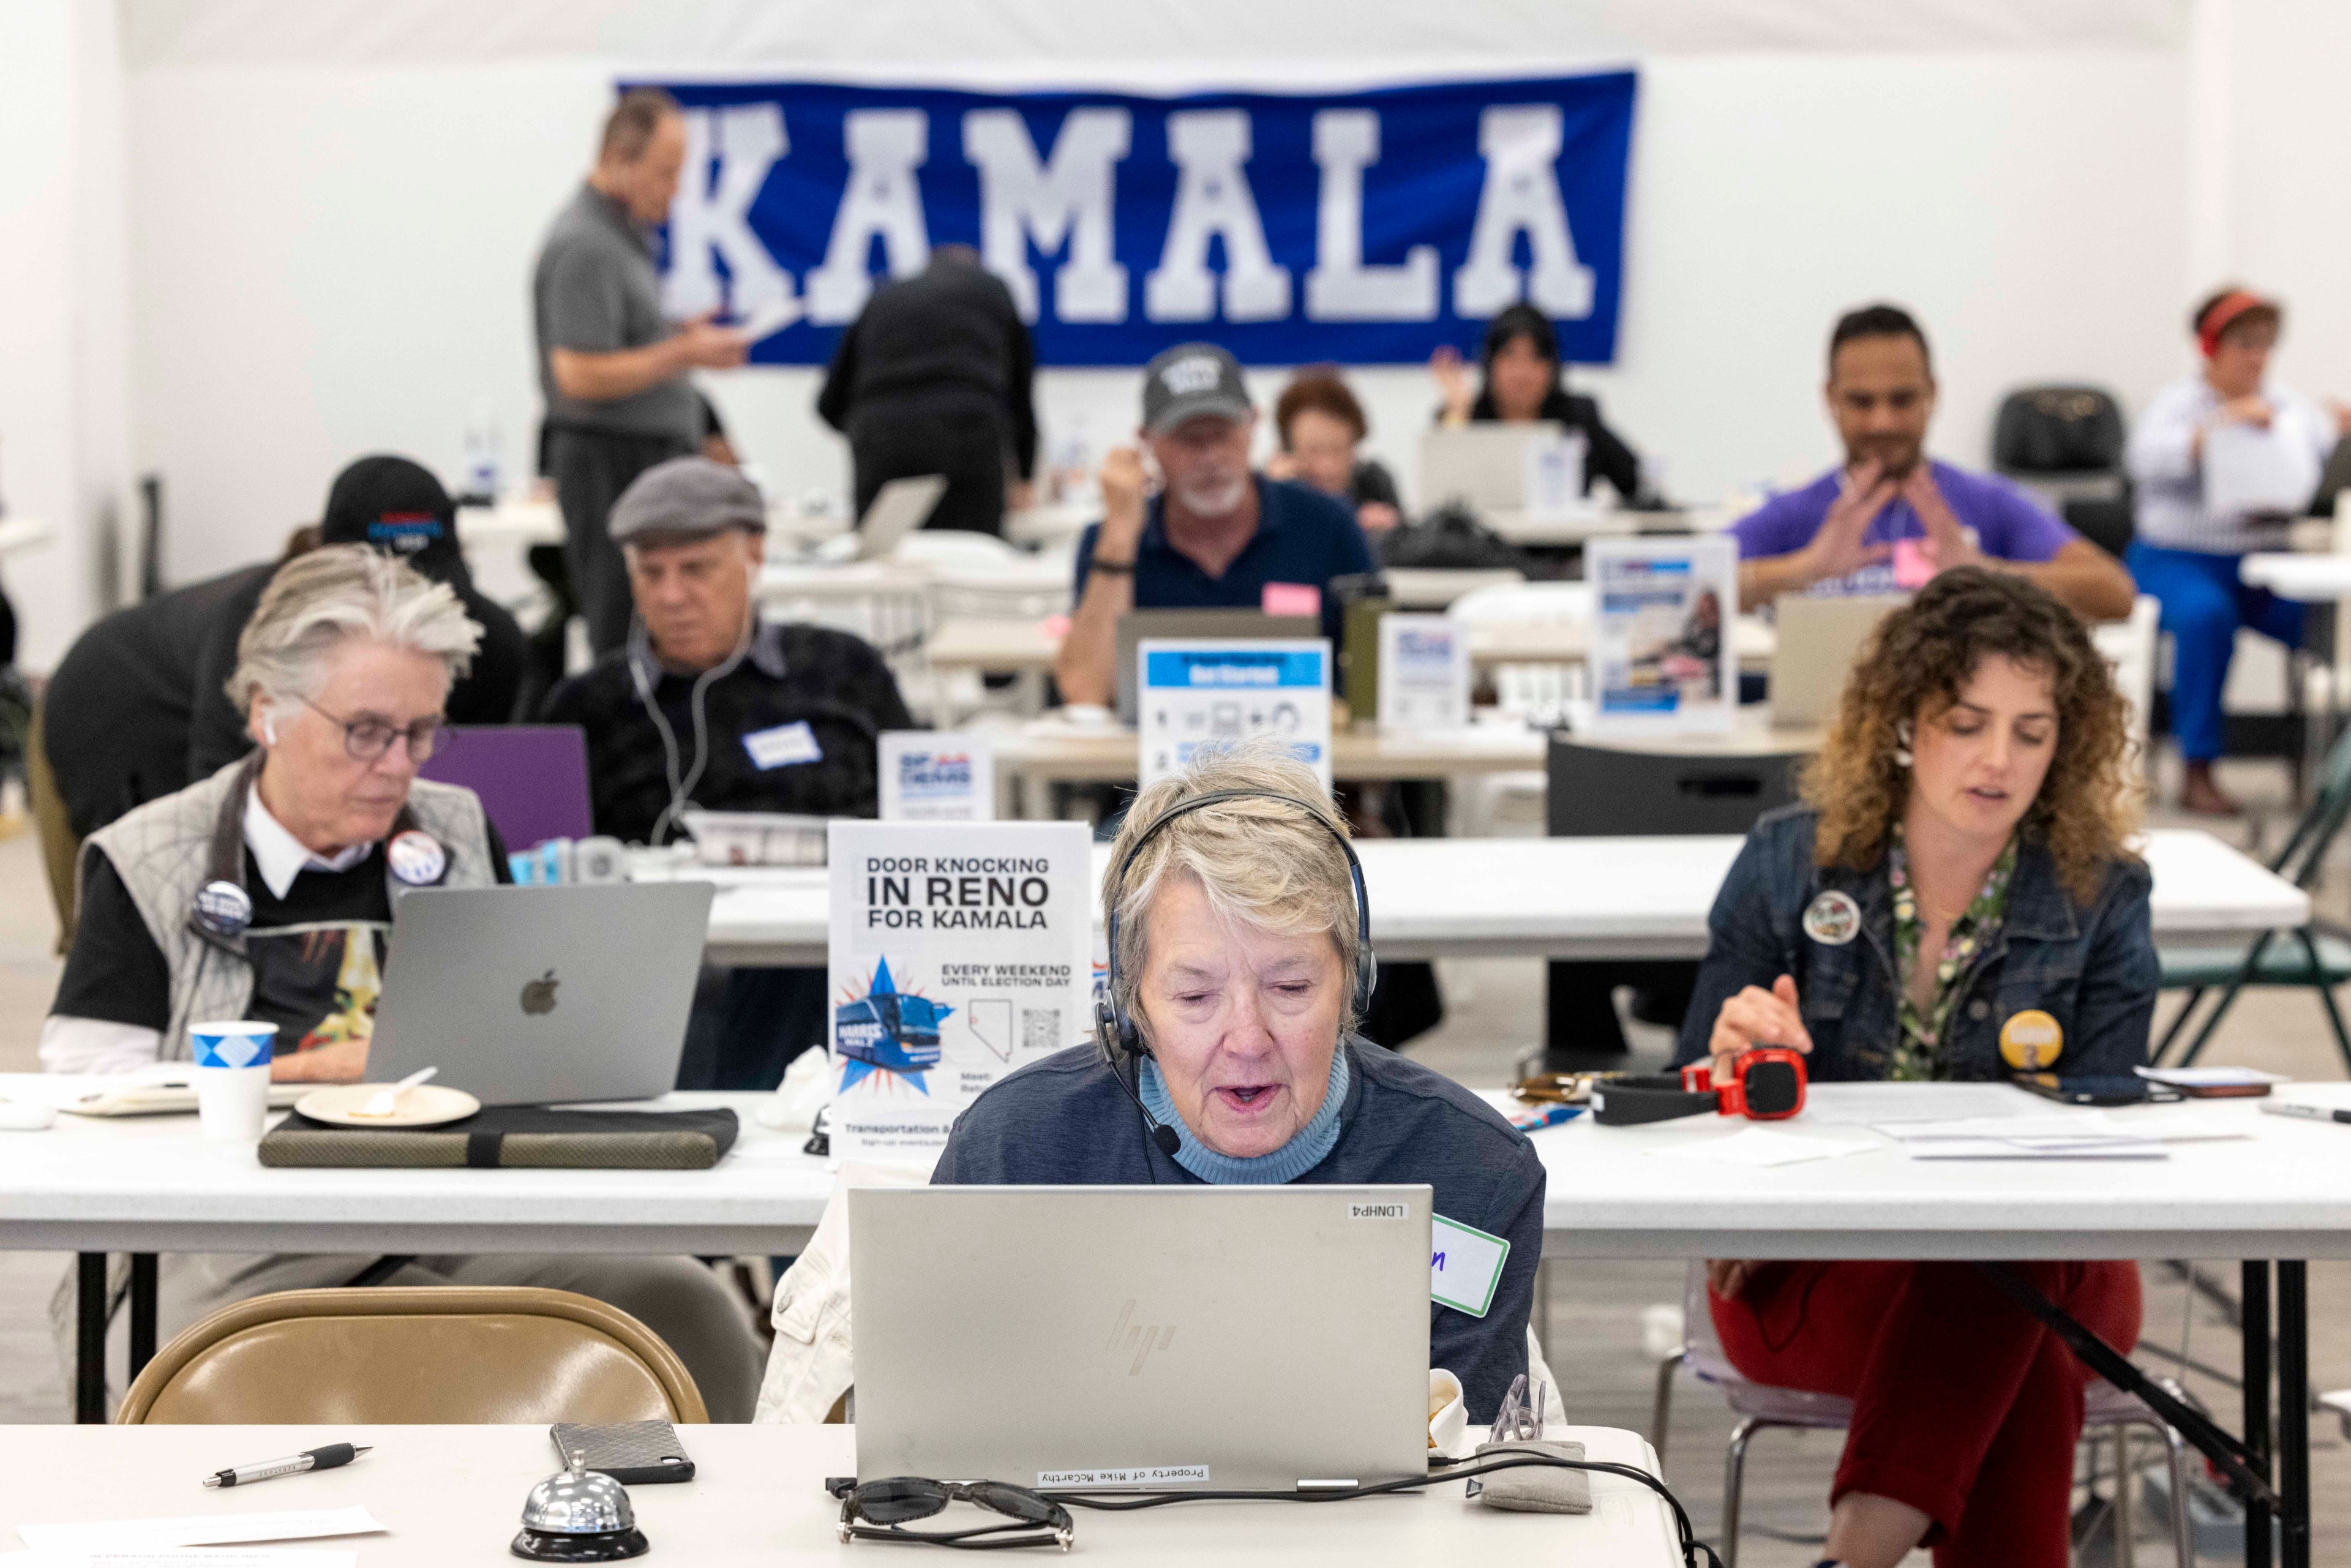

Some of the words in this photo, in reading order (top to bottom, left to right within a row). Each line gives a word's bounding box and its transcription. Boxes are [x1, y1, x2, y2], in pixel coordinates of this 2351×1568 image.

[660, 102, 1596, 324] KAMALA
[867, 858, 928, 872] DOOR
[936, 858, 1049, 873] KNOCKING
[868, 877, 909, 906] IN
[927, 876, 1049, 907] RENO
[868, 909, 923, 929] FOR
[933, 910, 1048, 929] KAMALA
[942, 964, 990, 975] EVERY
[993, 964, 1070, 976] WEEKEND
[942, 977, 977, 986] UNTIL
[981, 977, 1042, 986] ELECTION
[1046, 977, 1070, 986] DAY
[846, 1124, 939, 1135] Transportation
[1352, 1205, 1403, 1217] LDNHP4
[260, 1465, 296, 1477] REDSTONE
[1100, 1472, 1127, 1481] Mike
[1133, 1471, 1146, 1480] of
[1152, 1469, 1204, 1479] Property
[1041, 1473, 1094, 1482] McCarthy
